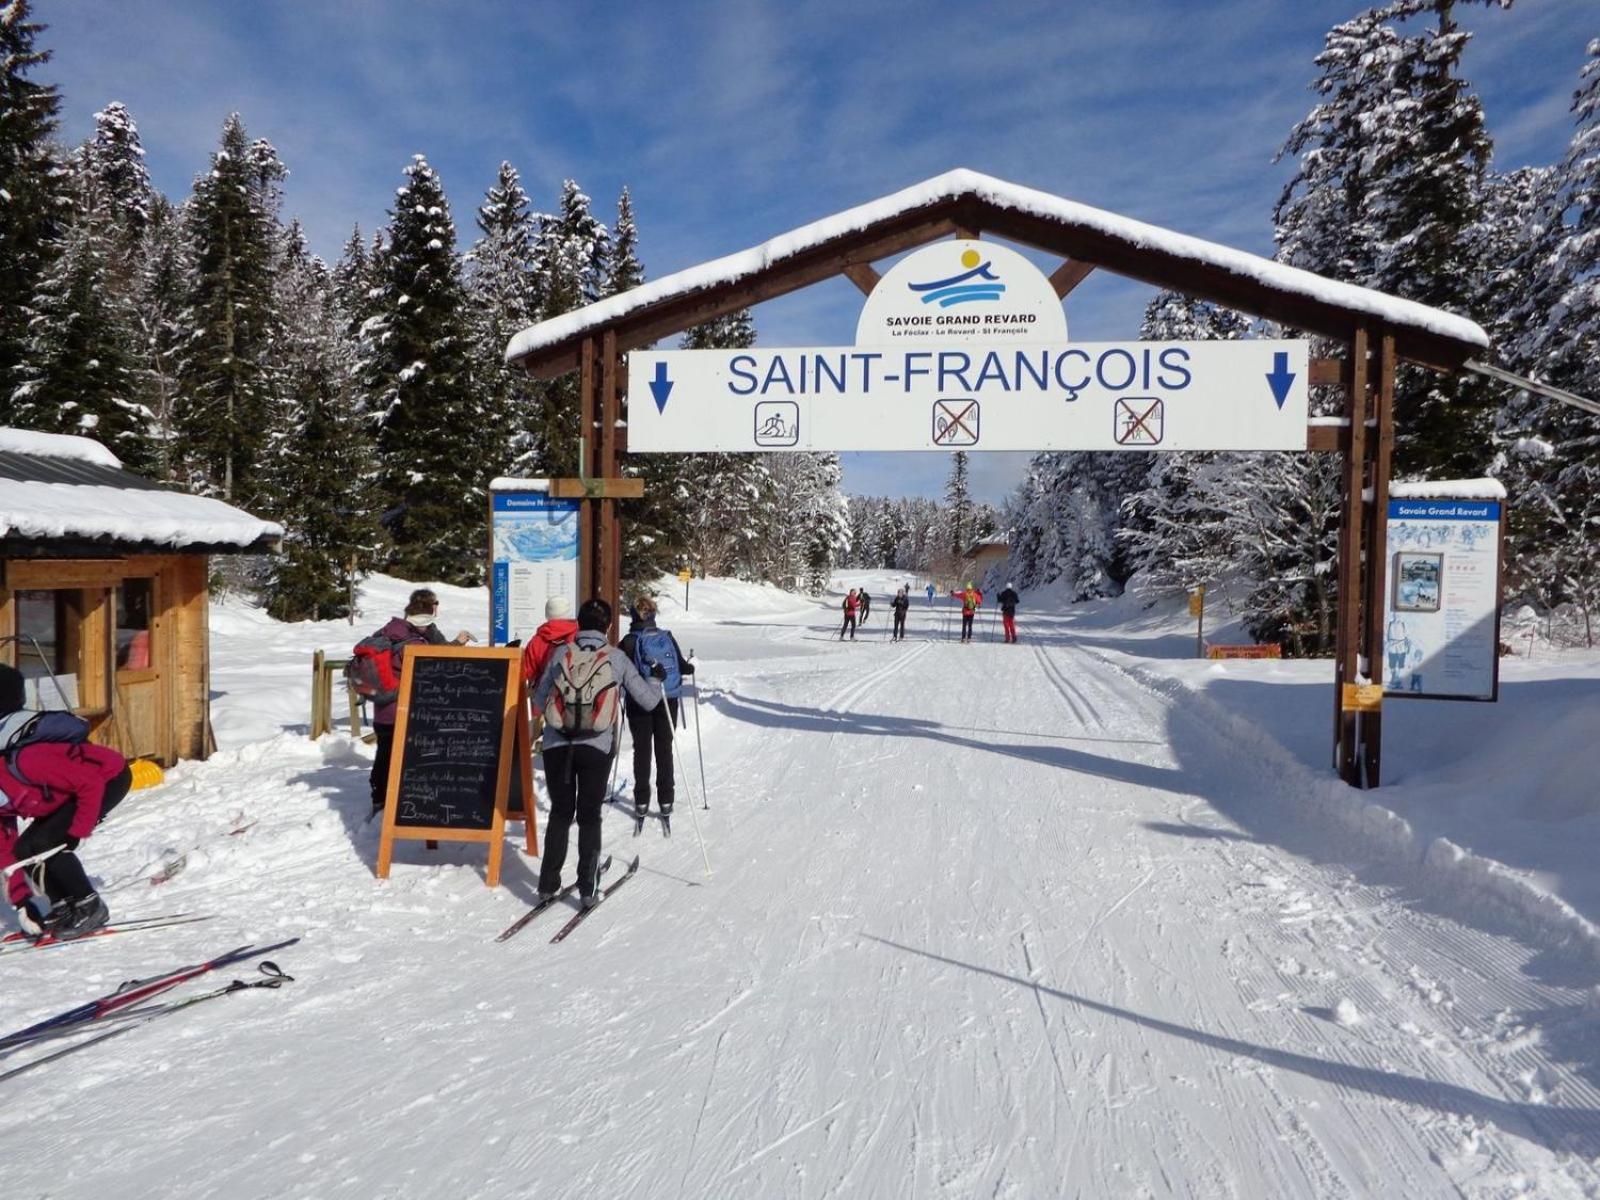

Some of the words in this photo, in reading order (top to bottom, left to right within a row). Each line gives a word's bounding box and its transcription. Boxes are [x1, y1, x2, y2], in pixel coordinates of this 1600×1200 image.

[886, 316, 932, 327] SAVOIE
[936, 315, 981, 326] GRAND
[984, 313, 1037, 325] REVARD
[727, 346, 1192, 402] SAINT-FRANÇOIS
[1398, 506, 1427, 515] Savoie
[1428, 506, 1456, 516] Grand
[1457, 507, 1488, 516] Revard
